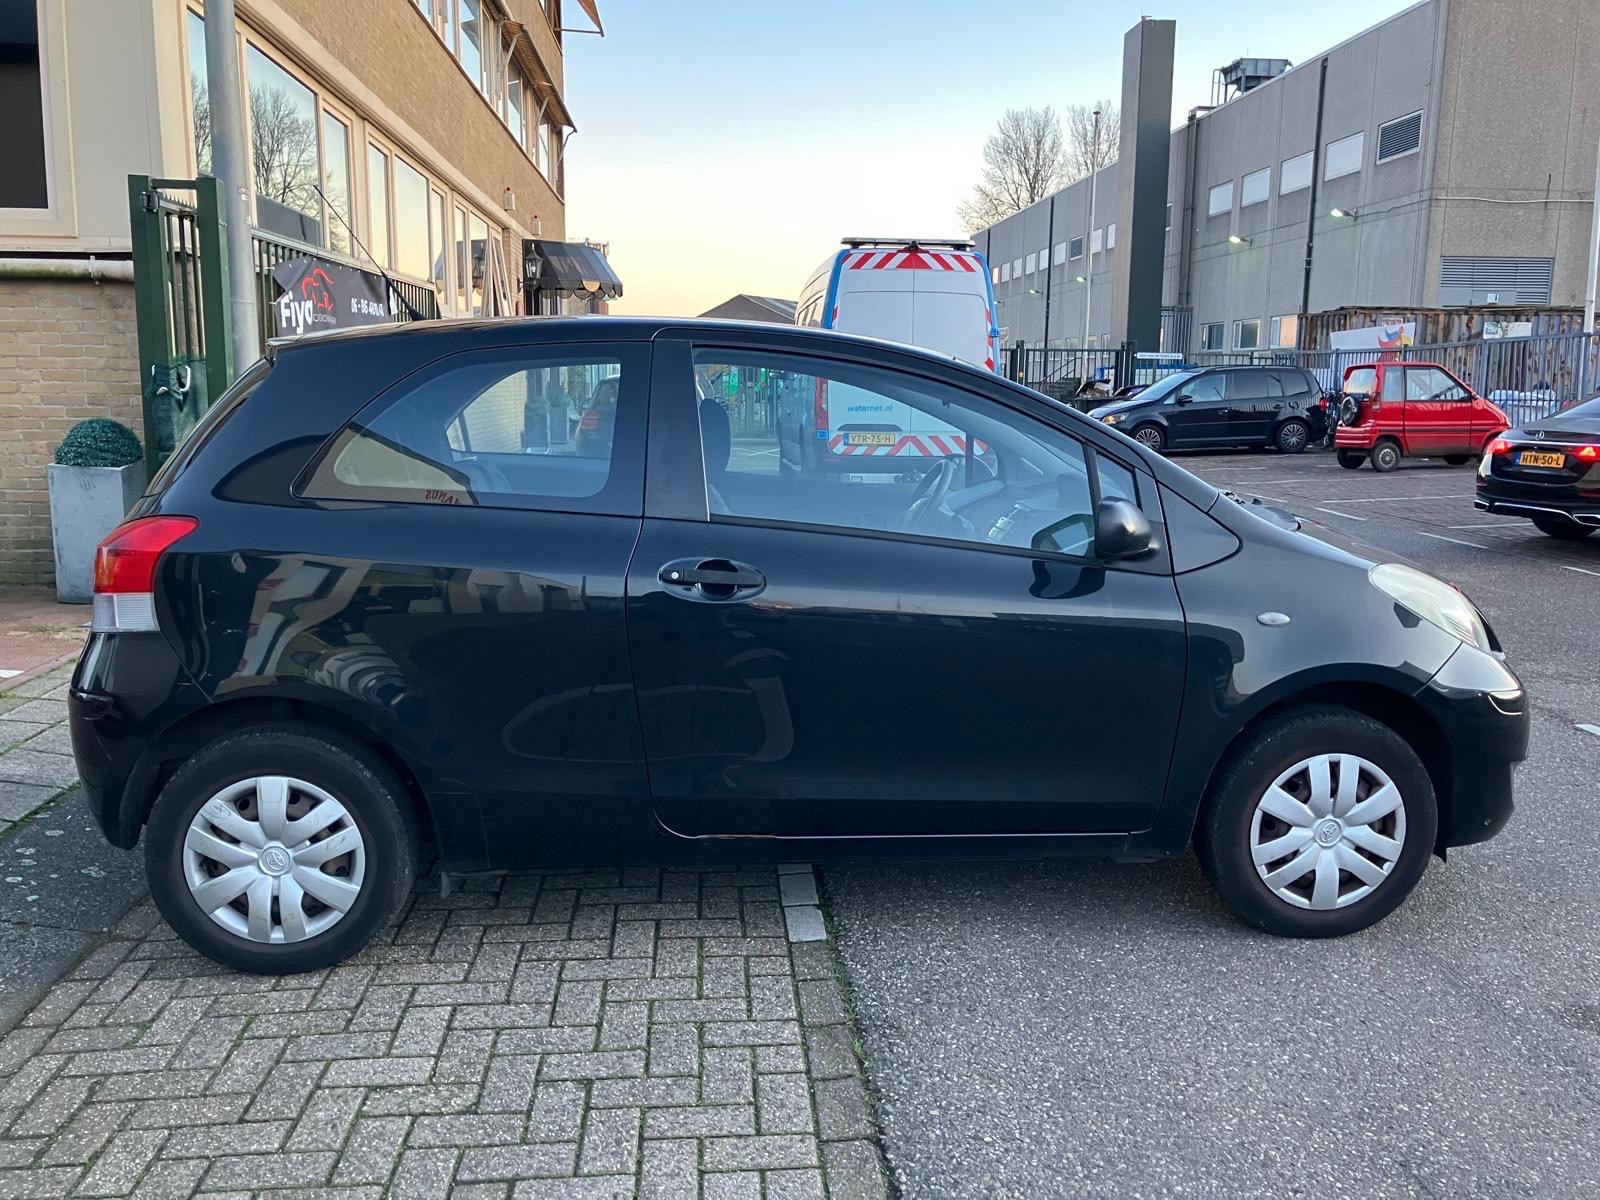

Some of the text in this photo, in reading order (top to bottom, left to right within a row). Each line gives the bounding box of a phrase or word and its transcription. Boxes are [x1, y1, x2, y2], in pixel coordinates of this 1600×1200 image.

[847, 404, 893, 413] waternet.nl
[851, 434, 891, 443] VTR-75-H
[1522, 454, 1561, 466] HTN-50-L
